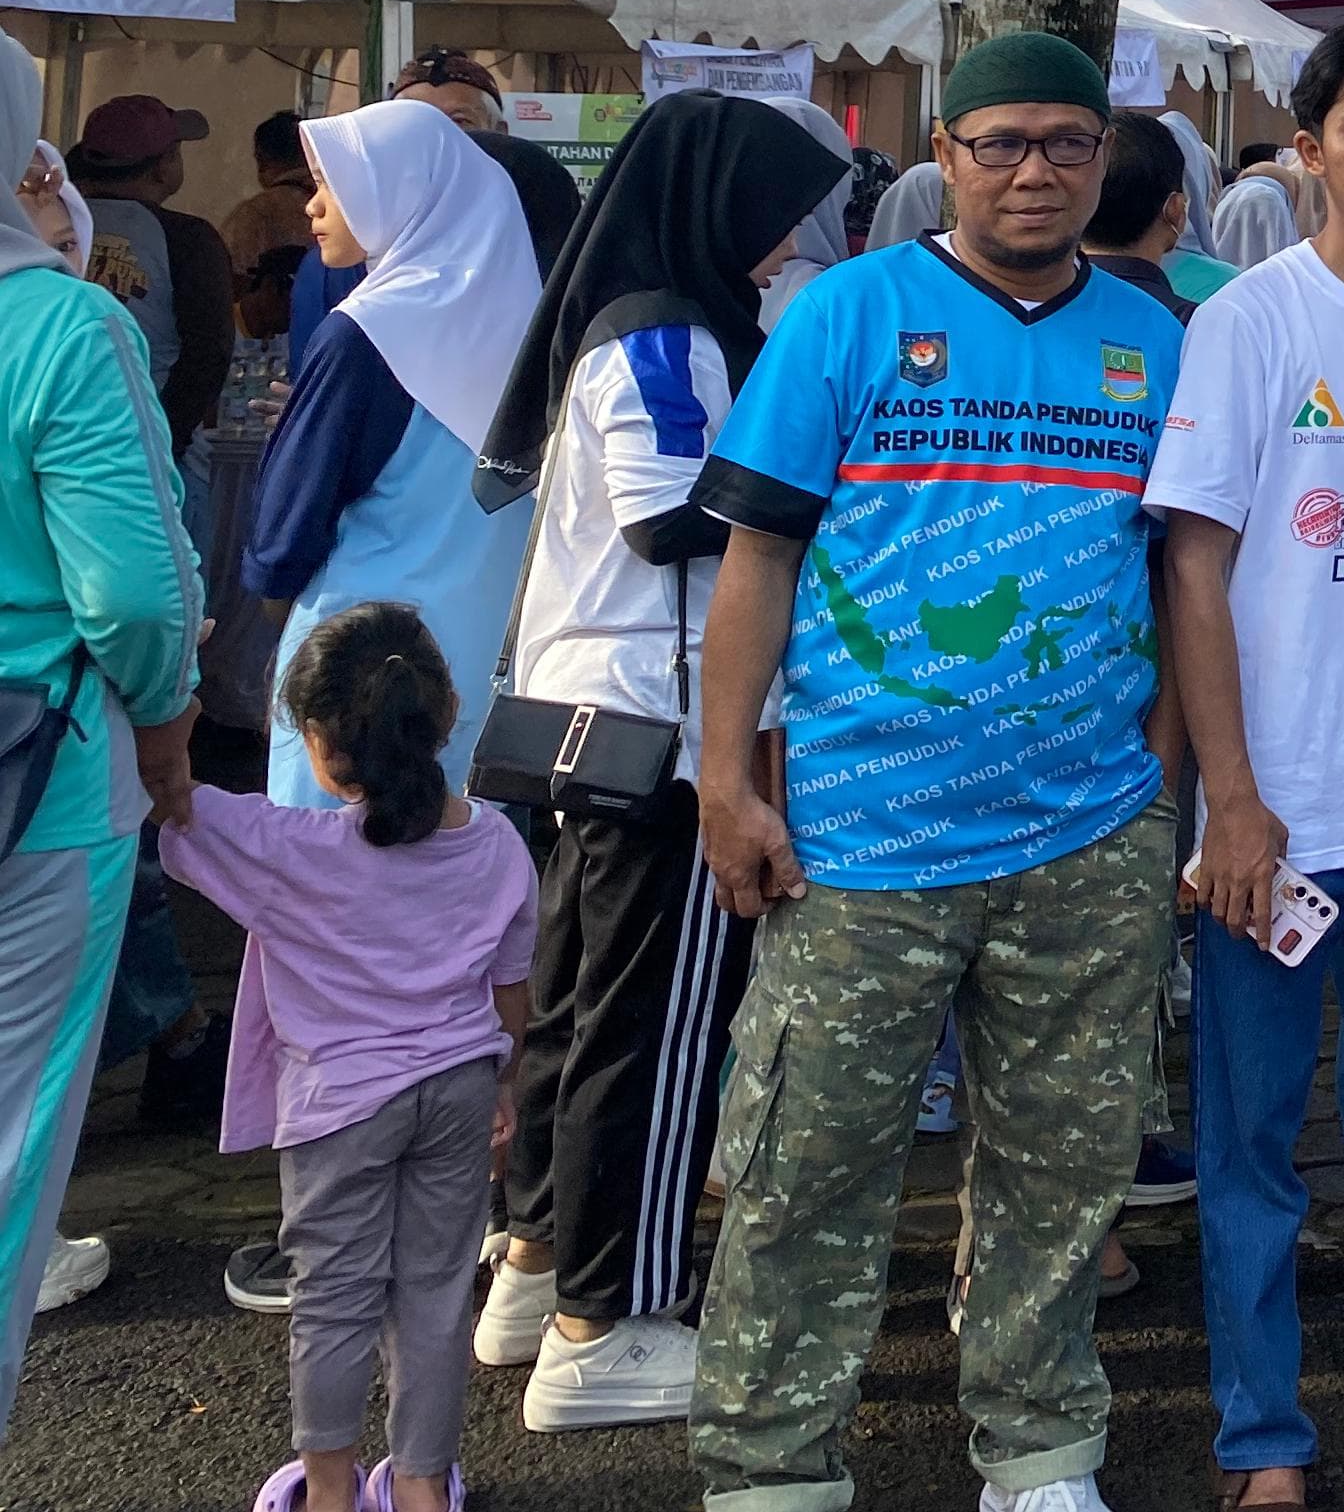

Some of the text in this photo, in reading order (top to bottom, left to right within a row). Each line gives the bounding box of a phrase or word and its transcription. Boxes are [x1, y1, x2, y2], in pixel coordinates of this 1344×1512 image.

[872, 397, 1160, 438] KAOS TANDA PENDUDUK
[873, 428, 1014, 453] REPUBLIK
[846, 542, 899, 575] TANDA
[900, 495, 1005, 550] PENDUDUK
[926, 549, 982, 582] KAOS
[983, 520, 1047, 557] TANDA
[1063, 538, 1109, 569] KAOS
[911, 653, 967, 682] KAOS
[876, 708, 933, 736] KAOS
[792, 735, 965, 798] TANDA PENDUDUK
[885, 784, 944, 813] KAOS
[946, 760, 1015, 792] TANDA
[1015, 706, 1104, 766] PENDUDUK
[974, 791, 1032, 819] KAOS
[1028, 759, 1088, 794] TANDA
[841, 816, 957, 869] PENDUDUK
[912, 852, 972, 886] KAOS
